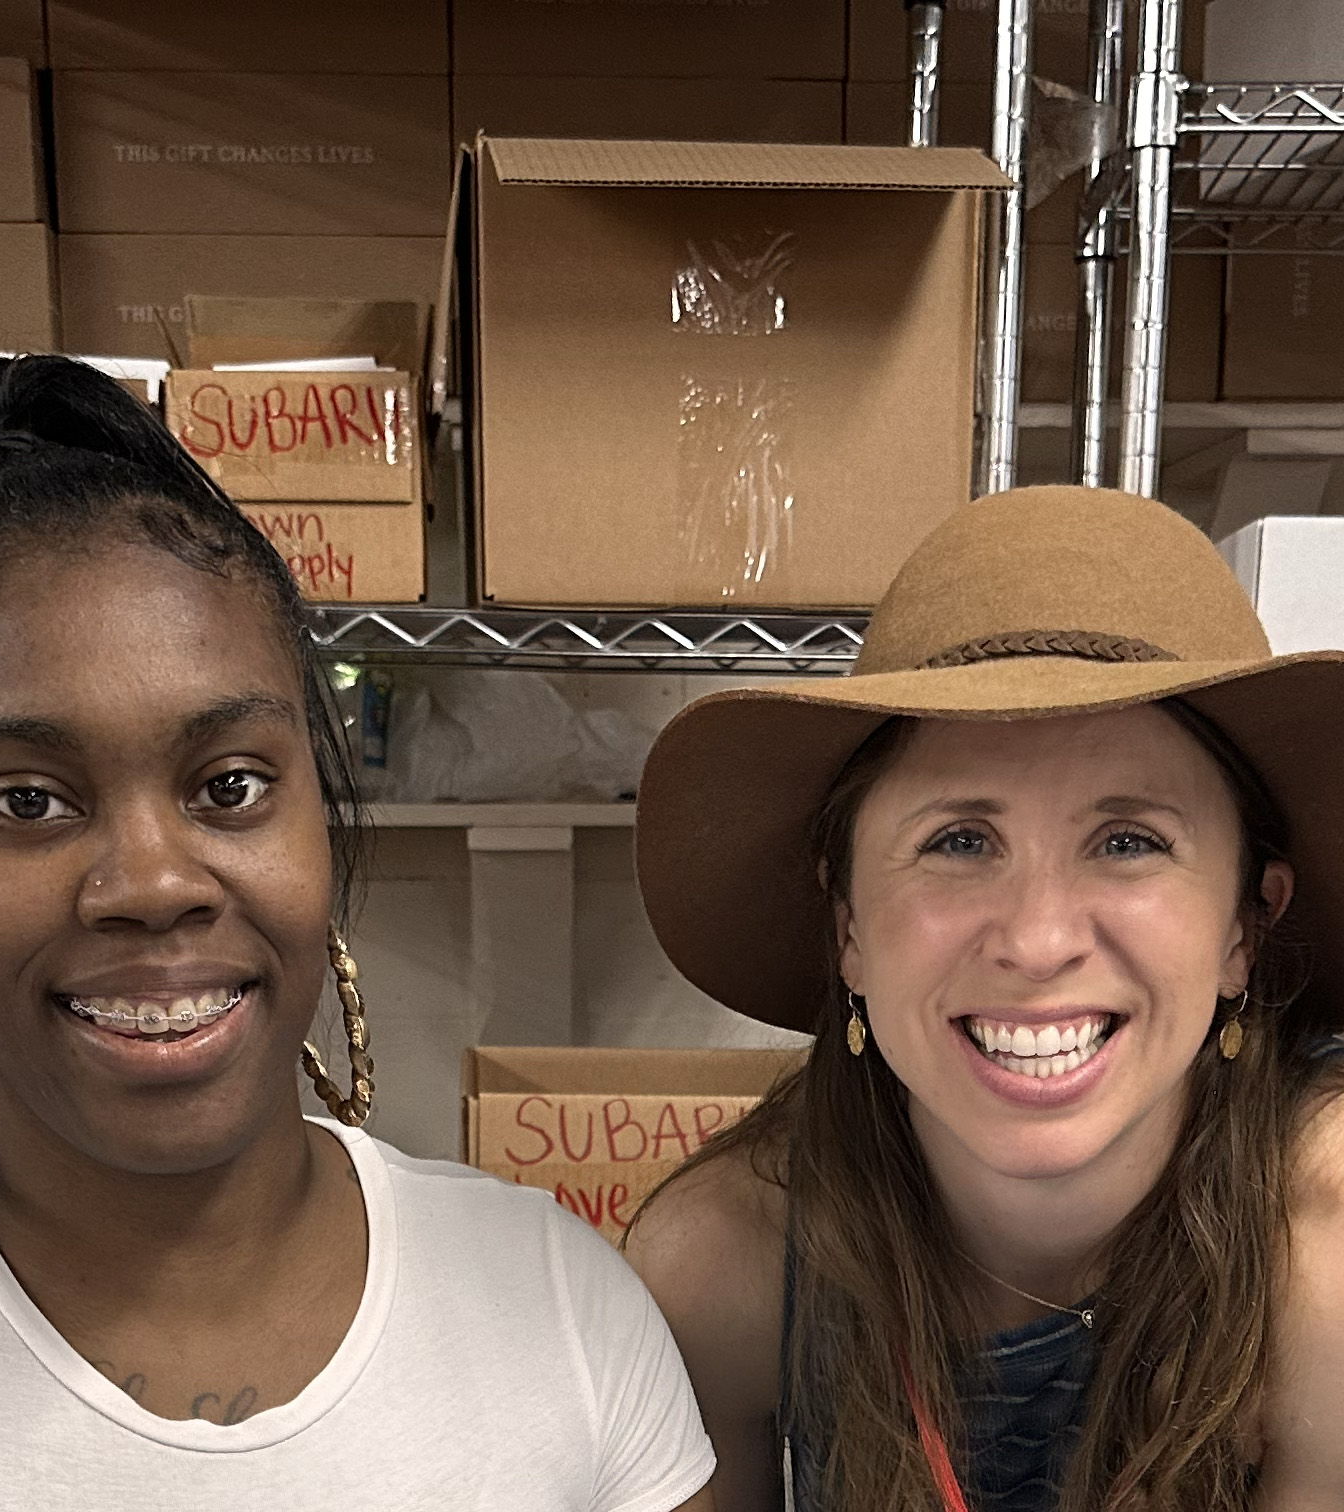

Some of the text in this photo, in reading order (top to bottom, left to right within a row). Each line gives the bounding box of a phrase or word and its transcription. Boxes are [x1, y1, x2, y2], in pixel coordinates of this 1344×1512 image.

[113, 144, 374, 165] THIS GIFT CHANGES LIVES
[180, 382, 401, 459] SUBARU
